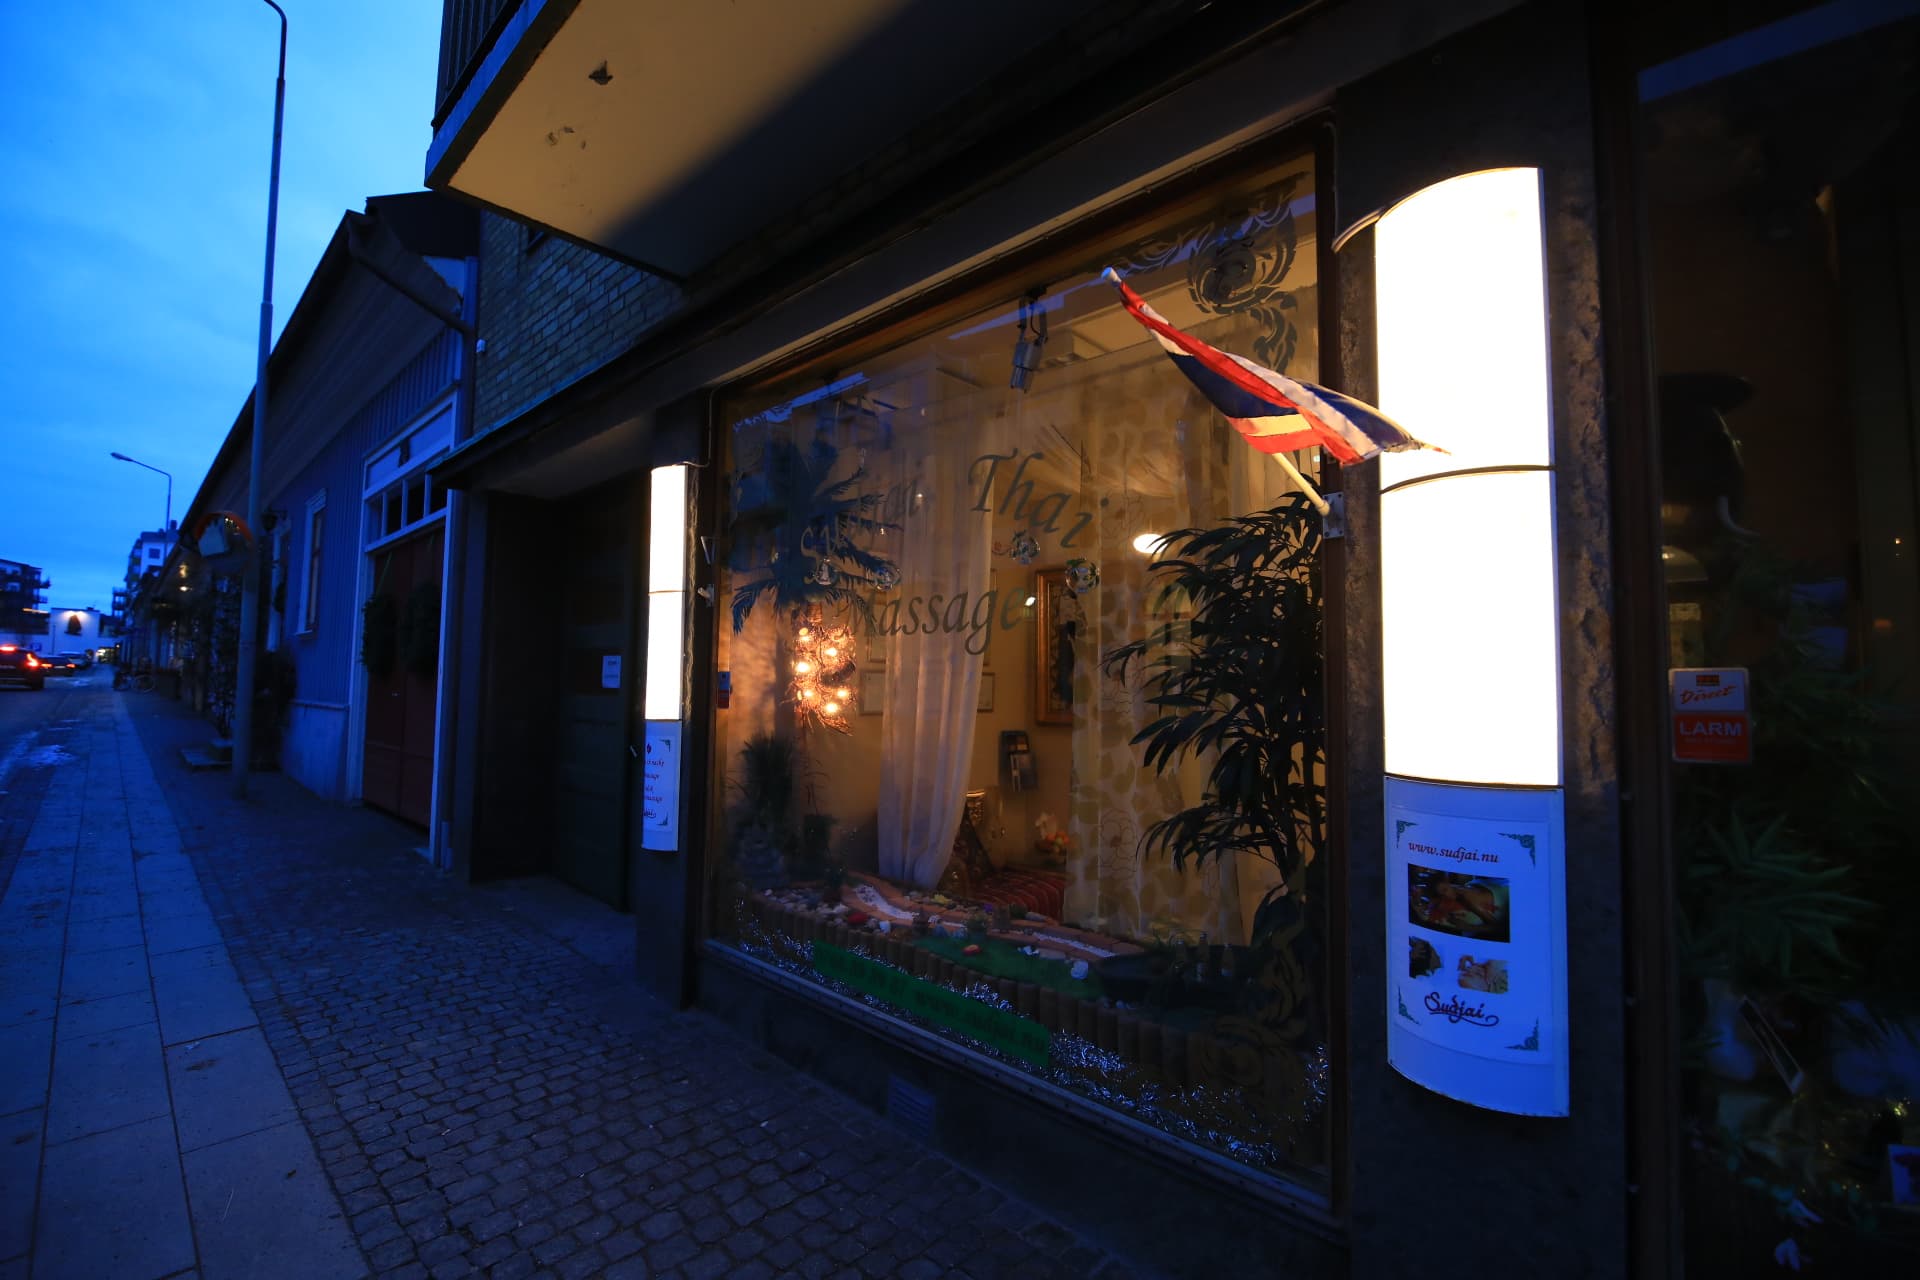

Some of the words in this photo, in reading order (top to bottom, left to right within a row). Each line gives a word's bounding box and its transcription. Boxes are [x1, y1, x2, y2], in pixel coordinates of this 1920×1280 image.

[967, 447, 1110, 549] Thai
[835, 585, 1027, 656] Massage
[1680, 721, 1743, 737] LARM
[1408, 841, 1499, 863] www.sudjai.nu
[1424, 991, 1500, 1027] Sudjai
